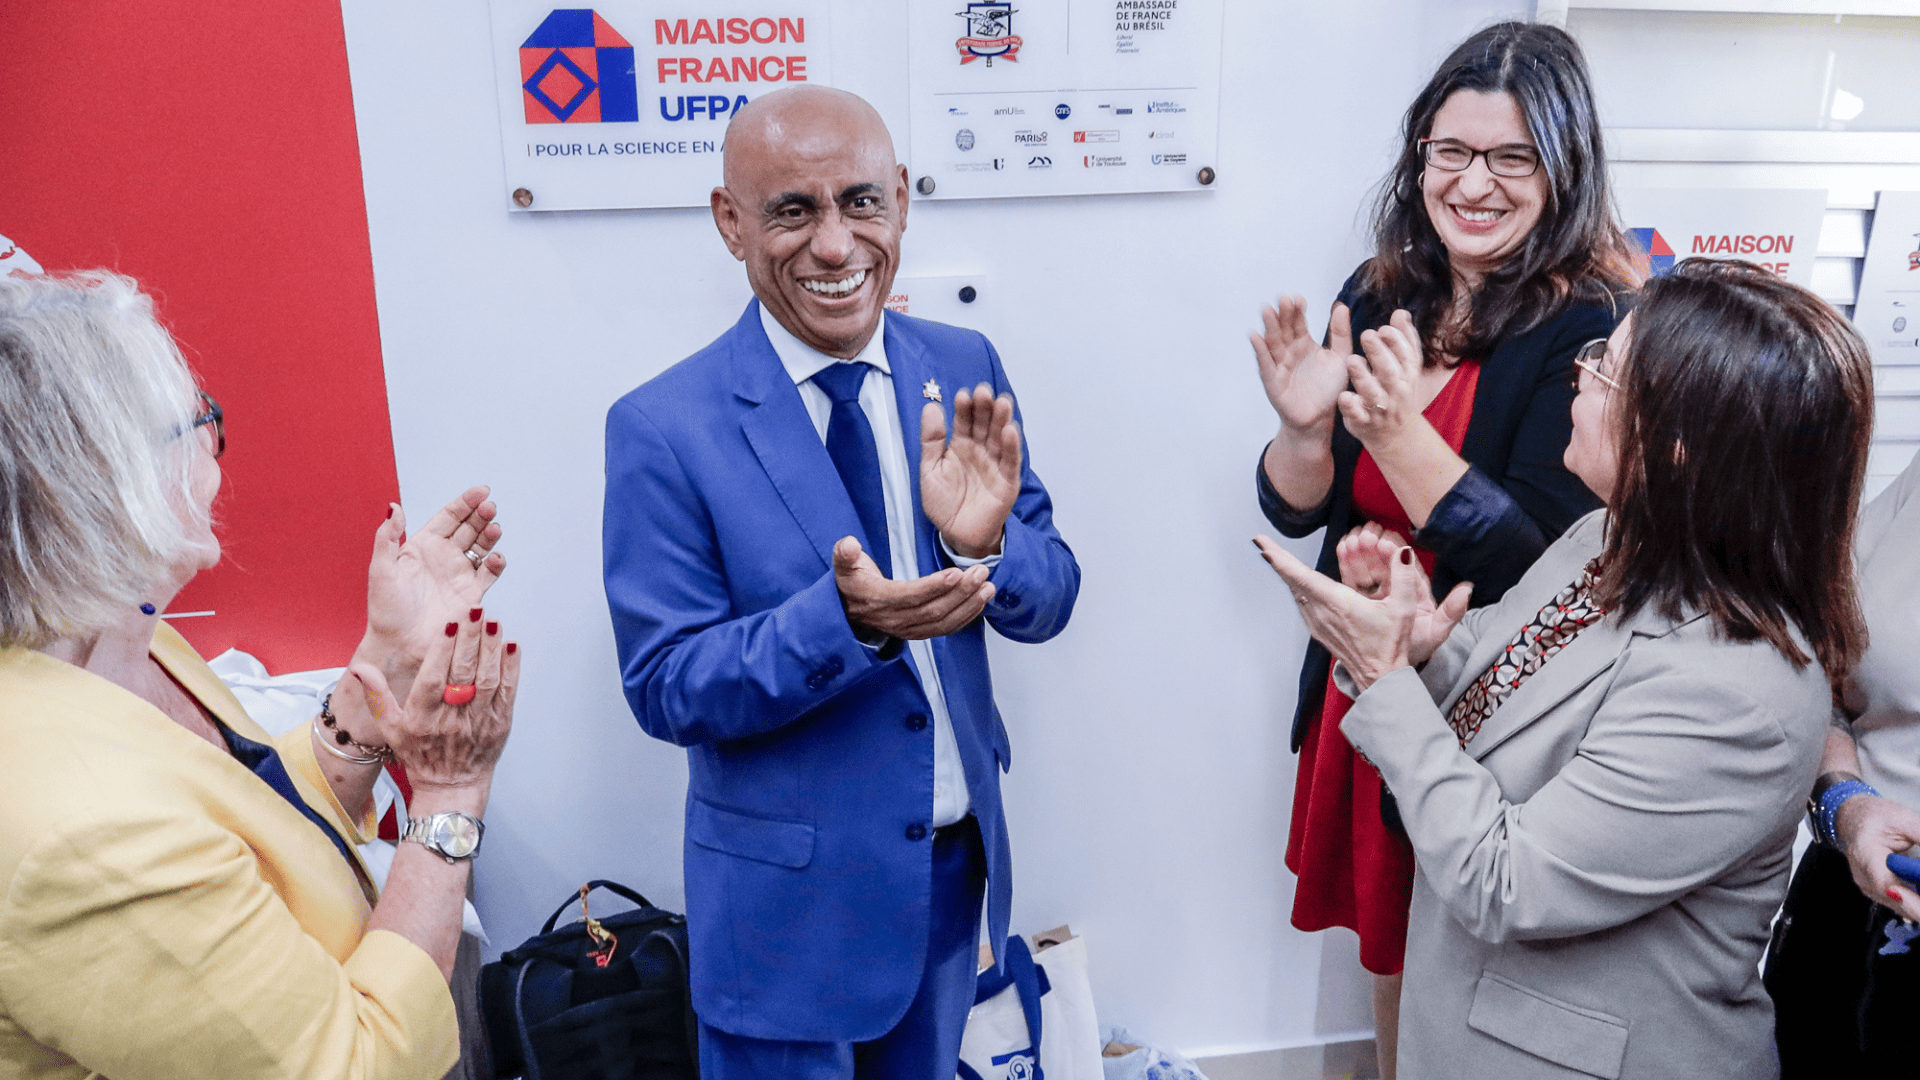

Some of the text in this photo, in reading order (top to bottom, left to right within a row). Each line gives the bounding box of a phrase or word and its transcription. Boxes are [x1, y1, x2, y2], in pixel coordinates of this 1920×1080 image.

[1116, 0, 1177, 10] AMBASSADE
[1116, 11, 1172, 20] DE FRANCE
[654, 17, 806, 46] MAISON
[1116, 20, 1165, 31] AU BRÉSIL
[657, 55, 808, 84] FRANCE
[536, 143, 583, 157] POUR
[588, 143, 610, 156] LA
[615, 141, 688, 156] SCIENCE
[692, 141, 715, 154] EN
[1691, 235, 1795, 254] MAISON
[886, 294, 908, 303] SON
